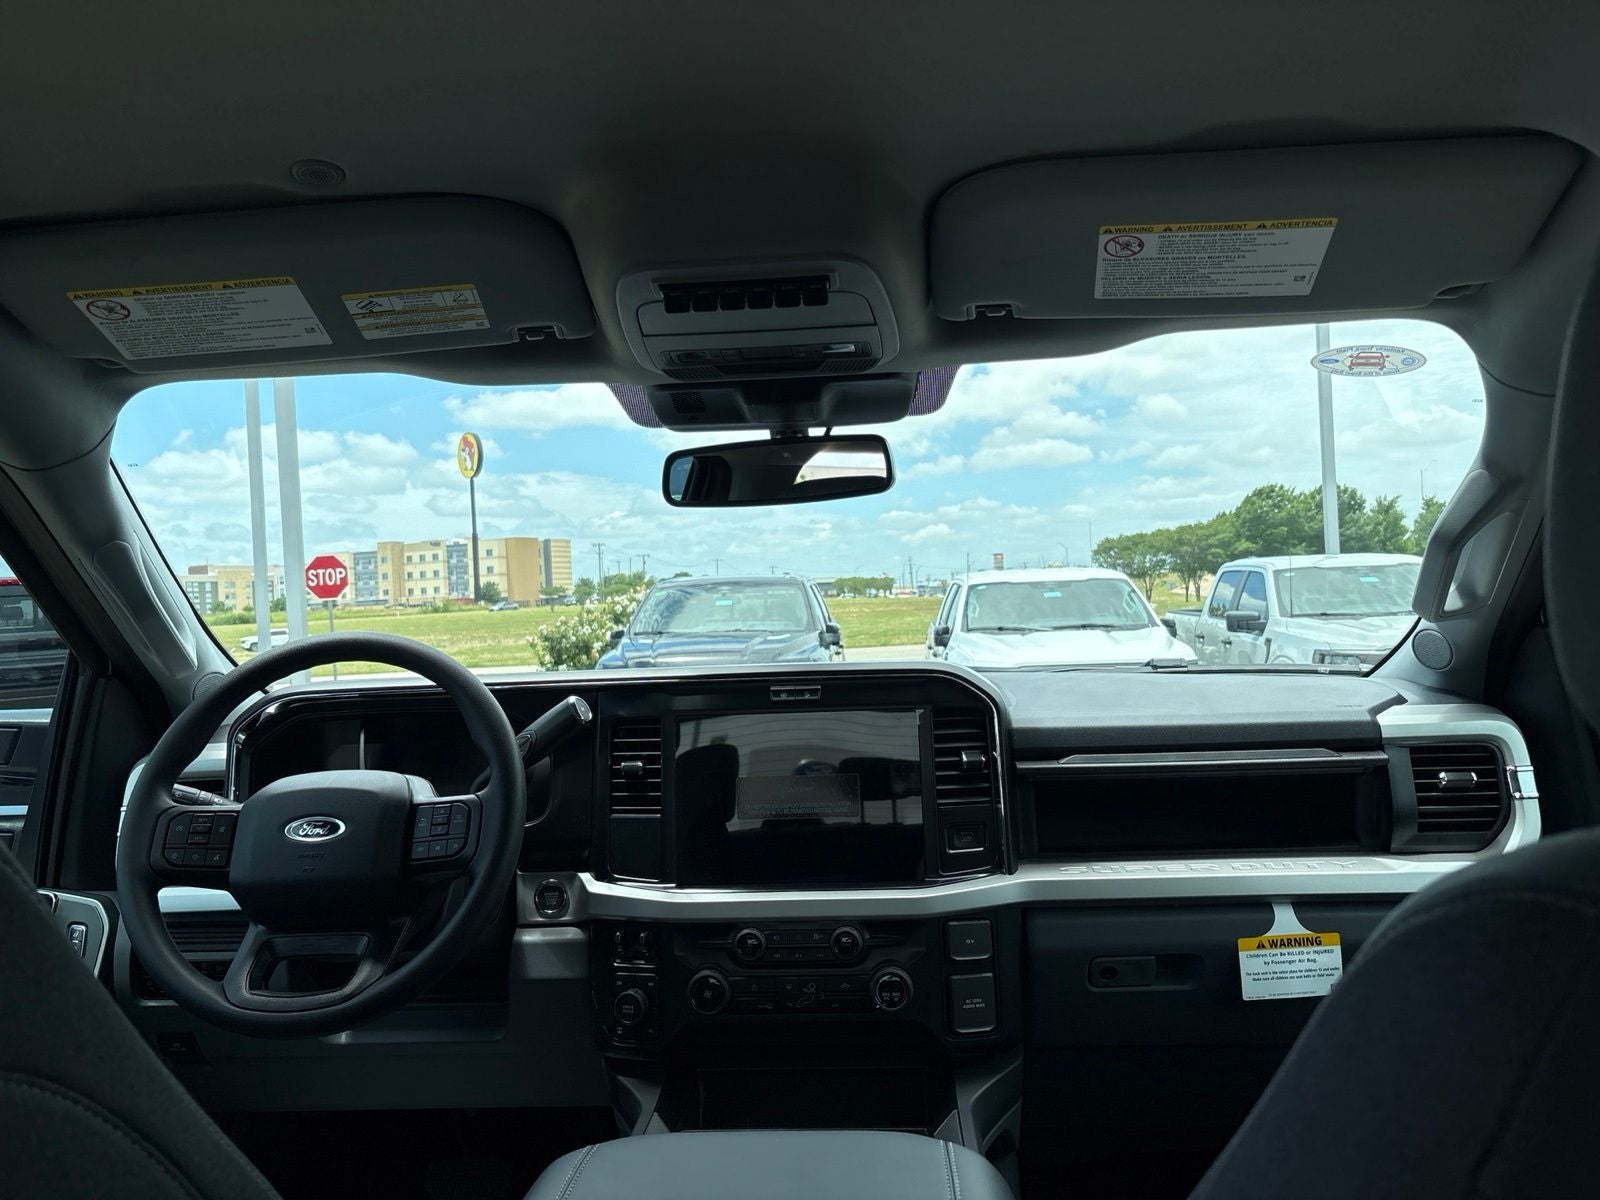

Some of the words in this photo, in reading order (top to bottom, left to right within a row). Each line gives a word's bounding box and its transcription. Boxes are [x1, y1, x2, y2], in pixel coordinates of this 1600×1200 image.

[1114, 226, 1155, 234] WARNING
[1177, 223, 1249, 232] AVERTISSEMENT
[1269, 219, 1334, 229] ADVERTENCIA
[84, 290, 124, 298] WARNING
[145, 284, 212, 295] AVERTISSEMENT
[233, 277, 292, 289] ADVERTENCIA
[308, 567, 347, 587] STOP
[298, 821, 331, 836] Ford
[1059, 862, 1221, 876] SUPER
[1230, 860, 1359, 873] DUTY
[1267, 936, 1322, 949] WARNING
